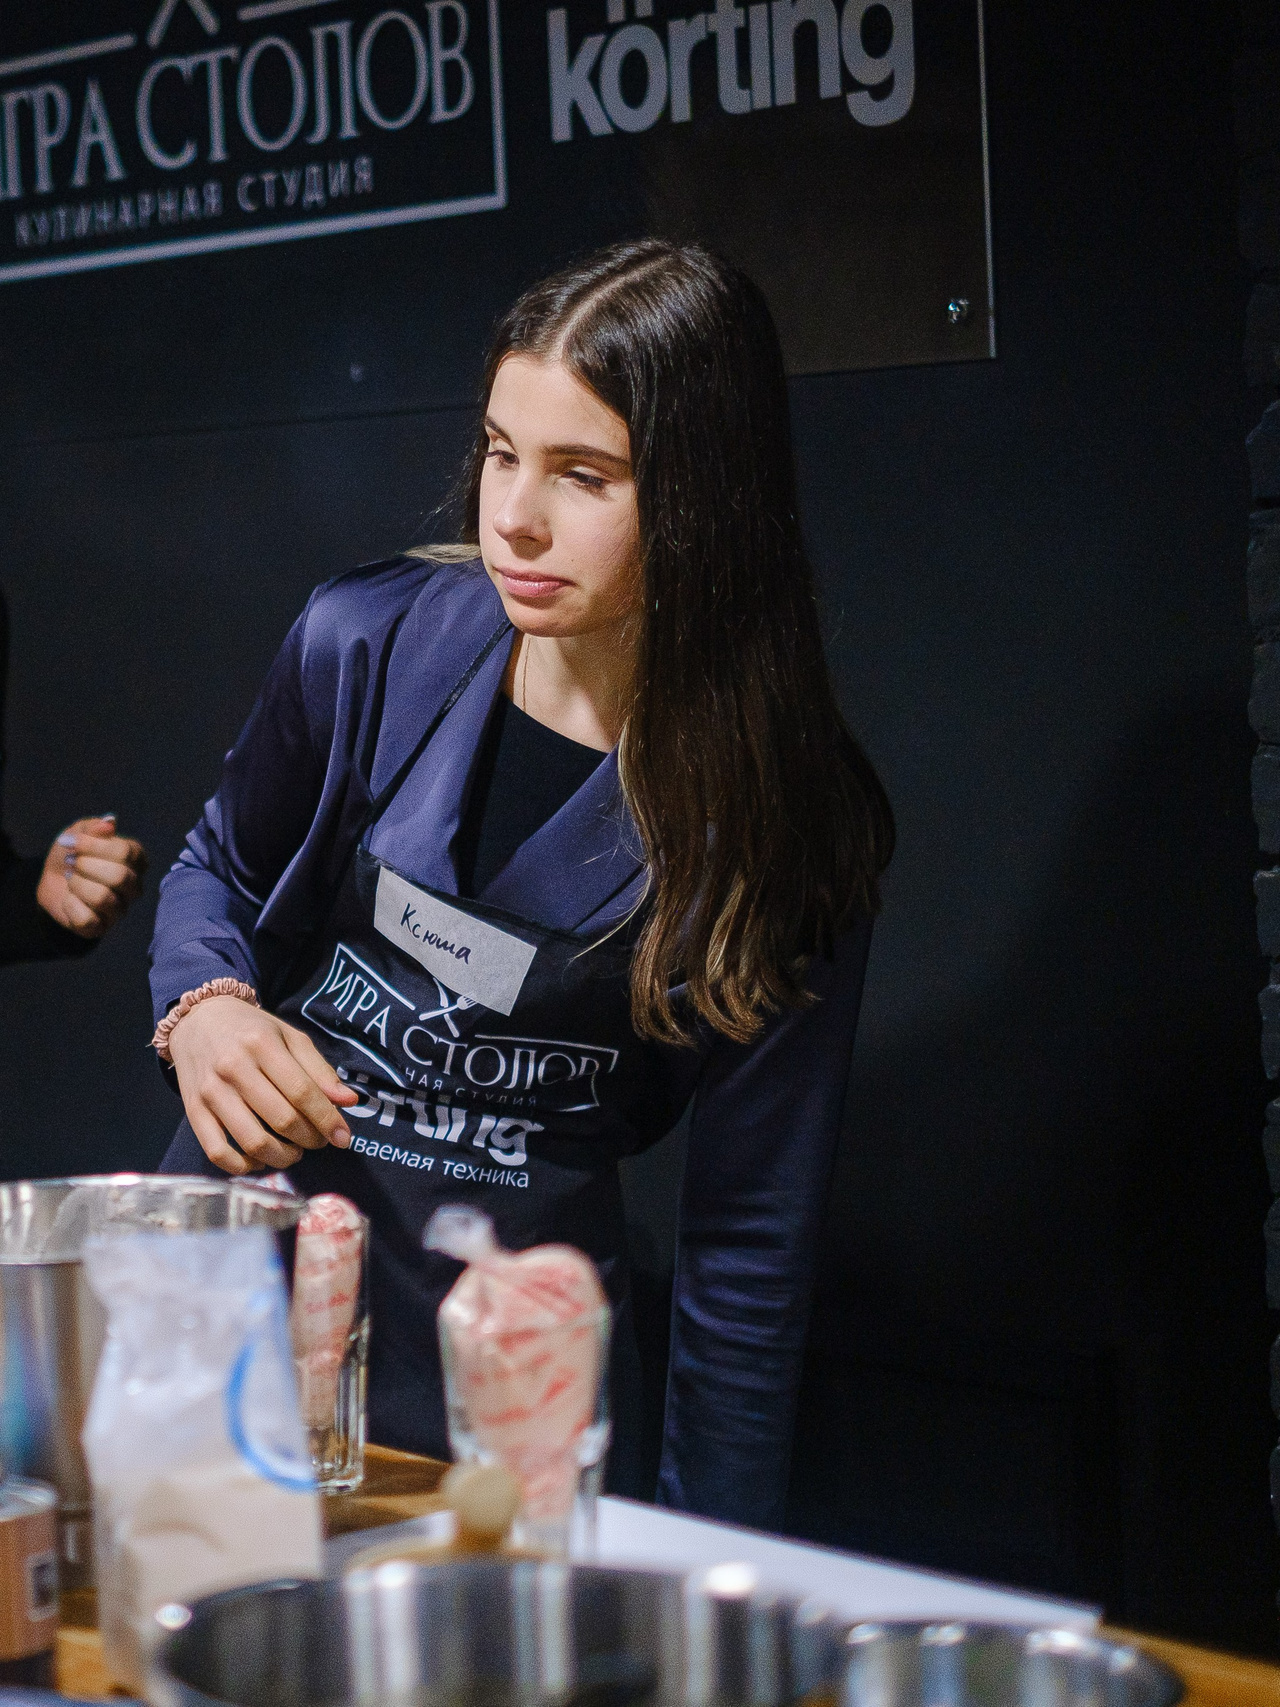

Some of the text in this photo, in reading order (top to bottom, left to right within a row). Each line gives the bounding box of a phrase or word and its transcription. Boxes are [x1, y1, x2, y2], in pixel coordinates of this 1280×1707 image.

[135, 0, 475, 170] СТОЛОВ
[546, 0, 917, 143] körting
[14, 154, 375, 249] КУЛИНАРНАЯ СТУДИЯ
[400, 902, 472, 965] Ксюша
[324, 957, 392, 1049] ИГРА
[442, 1157, 530, 1189] техника
